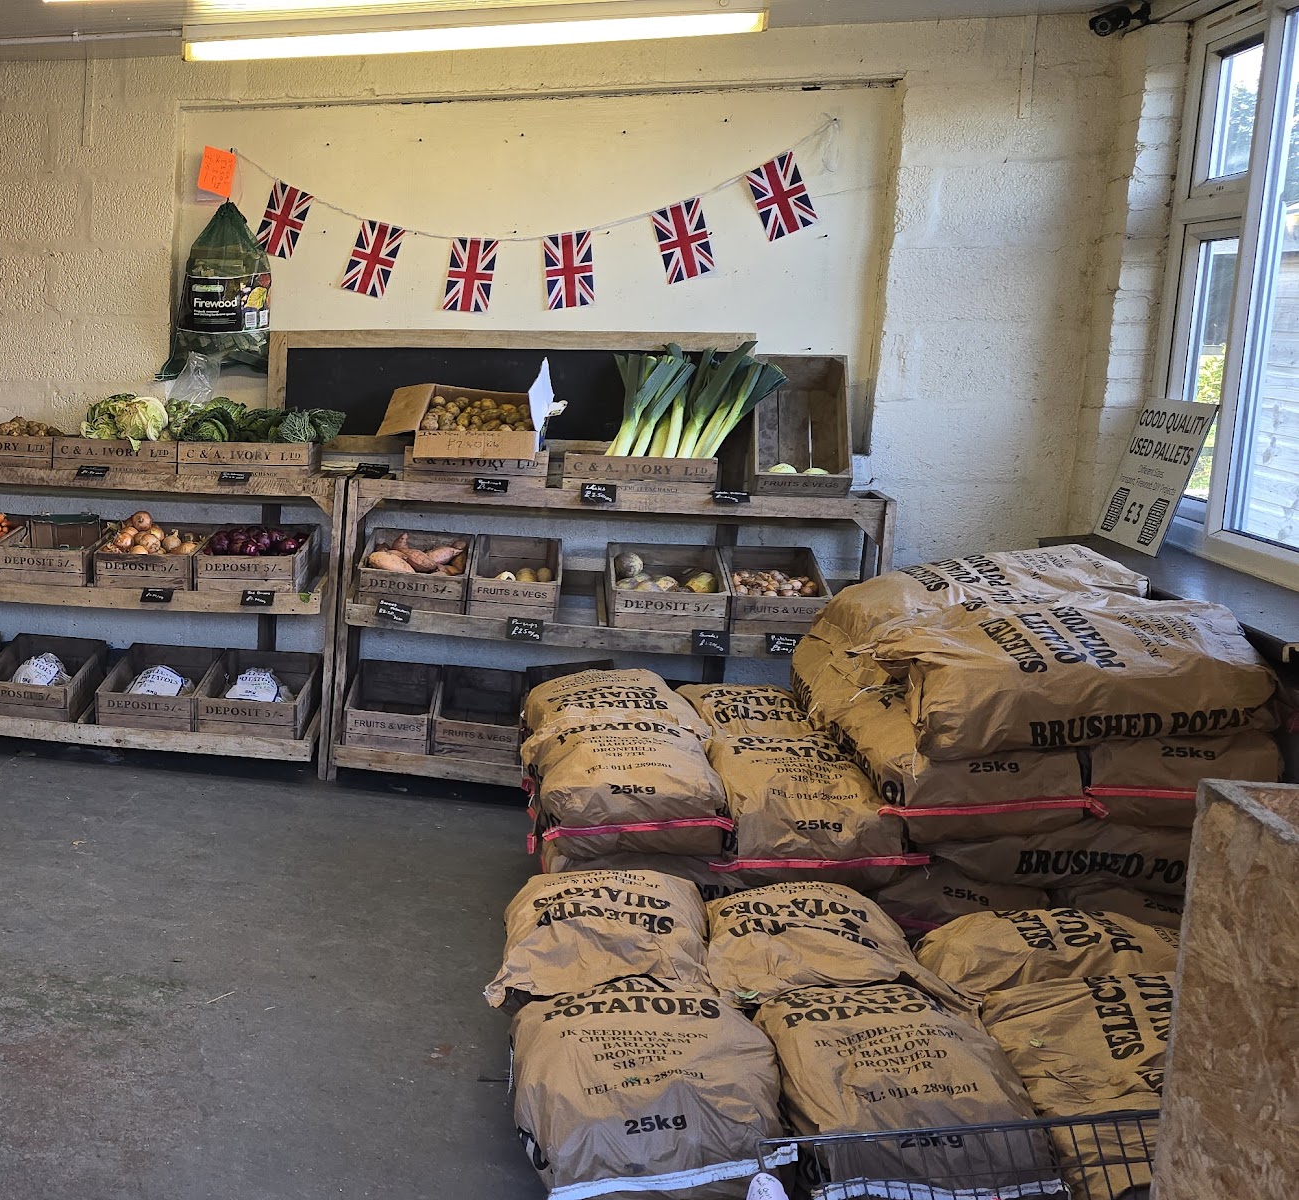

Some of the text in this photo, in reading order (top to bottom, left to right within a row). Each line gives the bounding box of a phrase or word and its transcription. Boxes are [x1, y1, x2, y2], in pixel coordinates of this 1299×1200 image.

[193, 297, 238, 309] Firewood
[1139, 408, 1210, 436] GOOD QUALITY
[60, 445, 69, 455] C
[72, 446, 83, 455] &
[85, 446, 98, 456] A.
[102, 446, 141, 458] IVORY
[186, 449, 195, 459] C
[199, 450, 210, 459] &
[213, 450, 226, 460] A.
[230, 449, 273, 461] IVORY
[1129, 436, 1195, 466] USED PALLETS
[412, 457, 420, 465] C
[426, 458, 437, 466] &
[440, 458, 456, 467] A.
[461, 458, 506, 472] IVORY
[573, 460, 583, 472] C
[588, 461, 600, 472] &
[604, 462, 620, 474] A.
[624, 463, 674, 476] IVORY
[763, 480, 800, 488] FRUITS
[811, 481, 840, 489] VEGS
[1123, 501, 1145, 525] £3
[4, 555, 75, 568] DEPOSIT 5/-
[104, 561, 179, 573] DEPOSIT 5/-
[204, 562, 283, 573] DEPOSIT 5/-
[369, 578, 453, 595] DEPOSIT 5/-
[476, 586, 548, 599] FRUITS & VEGS
[623, 598, 716, 613] DEPOSIT 5/-
[743, 605, 820, 615] FRUITS & VEGS
[107, 699, 162, 711] DEPOSIT
[205, 705, 262, 717] DEPOSIT
[353, 719, 422, 733] FRUITS & VEGS
[556, 721, 682, 746] POTATOES
[1029, 711, 1163, 748] BRUSHED
[442, 729, 512, 743] FRUITS & VEGS
[1161, 745, 1216, 761] 25kg
[585, 761, 673, 775] TEL: 0114 2890201
[776, 768, 843, 780] DRONFIELD
[783, 763, 832, 774] BARLOW
[968, 760, 1021, 774] 25kg
[790, 775, 808, 783] S18
[610, 784, 656, 795] 25kg
[770, 787, 859, 801] TEL: 0114 2890201
[795, 819, 843, 833] 25kg
[1014, 850, 1145, 880] BRUSHED
[942, 885, 990, 907] 25kg
[1142, 898, 1185, 915] 25k
[536, 902, 675, 935] SELECTED
[542, 995, 721, 1023] POTATOES
[782, 1002, 928, 1029] POTATO
[559, 1029, 578, 1040] JK
[580, 1029, 657, 1037] NEEDHAM
[675, 1032, 709, 1040] SON
[813, 1039, 832, 1048] JK
[835, 1023, 914, 1047] NEEDHAM
[602, 1042, 670, 1050] BARLOW
[836, 1035, 898, 1059] CHURCH
[859, 1038, 931, 1059] BARLOW
[594, 1049, 683, 1063] DRONFIELD
[612, 1055, 667, 1070] S18 7TR
[853, 1049, 948, 1069] DRONFIELD
[903, 1061, 935, 1076] 7TR
[584, 1068, 705, 1096] TEL: 0114 2890201
[888, 1084, 919, 1099] 0114
[921, 1082, 980, 1096] 2890201
[624, 1114, 688, 1136] 25kg
